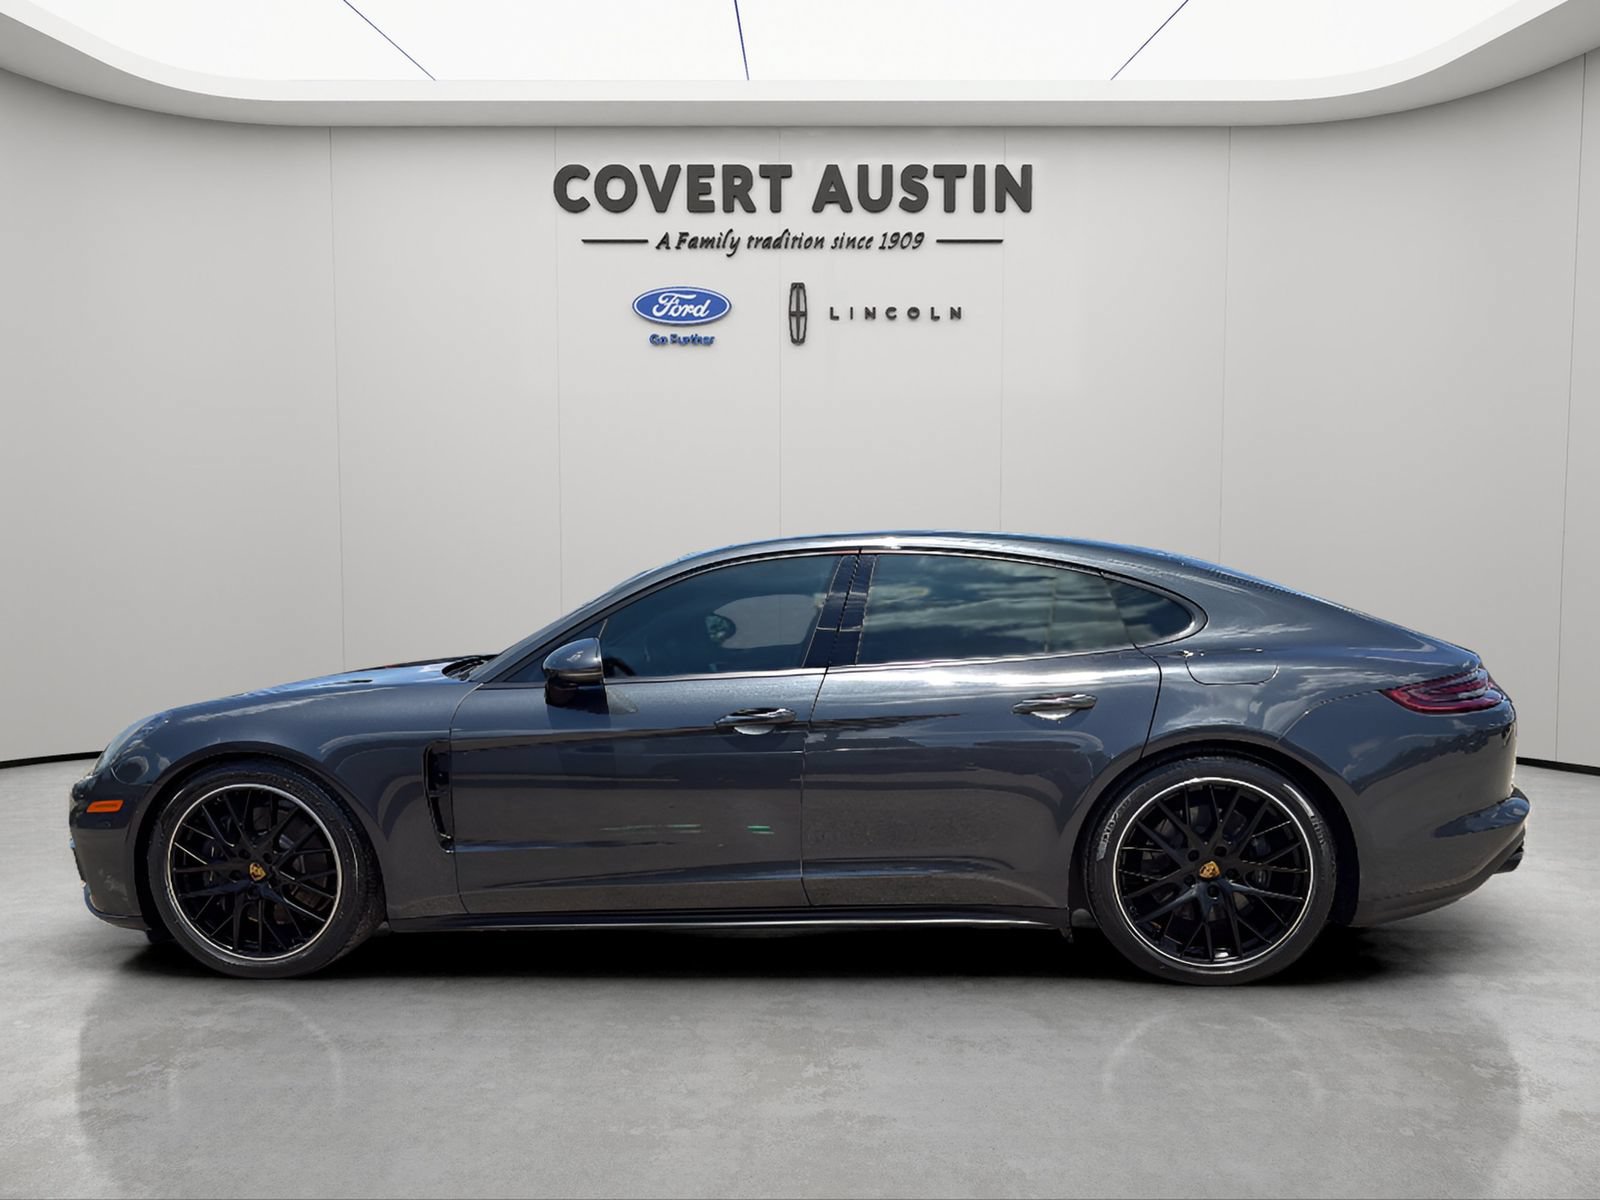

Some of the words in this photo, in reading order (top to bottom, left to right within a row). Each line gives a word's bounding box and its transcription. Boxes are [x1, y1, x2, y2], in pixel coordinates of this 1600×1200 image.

[553, 164, 792, 214] COVERT
[812, 164, 1033, 214] AUSTIN
[655, 231, 671, 251] A
[674, 229, 740, 258] Family
[746, 228, 825, 250] tradition
[830, 233, 874, 250] since
[878, 231, 925, 251] 1909
[652, 293, 711, 317] Ford
[829, 306, 963, 321] LINCOLN
